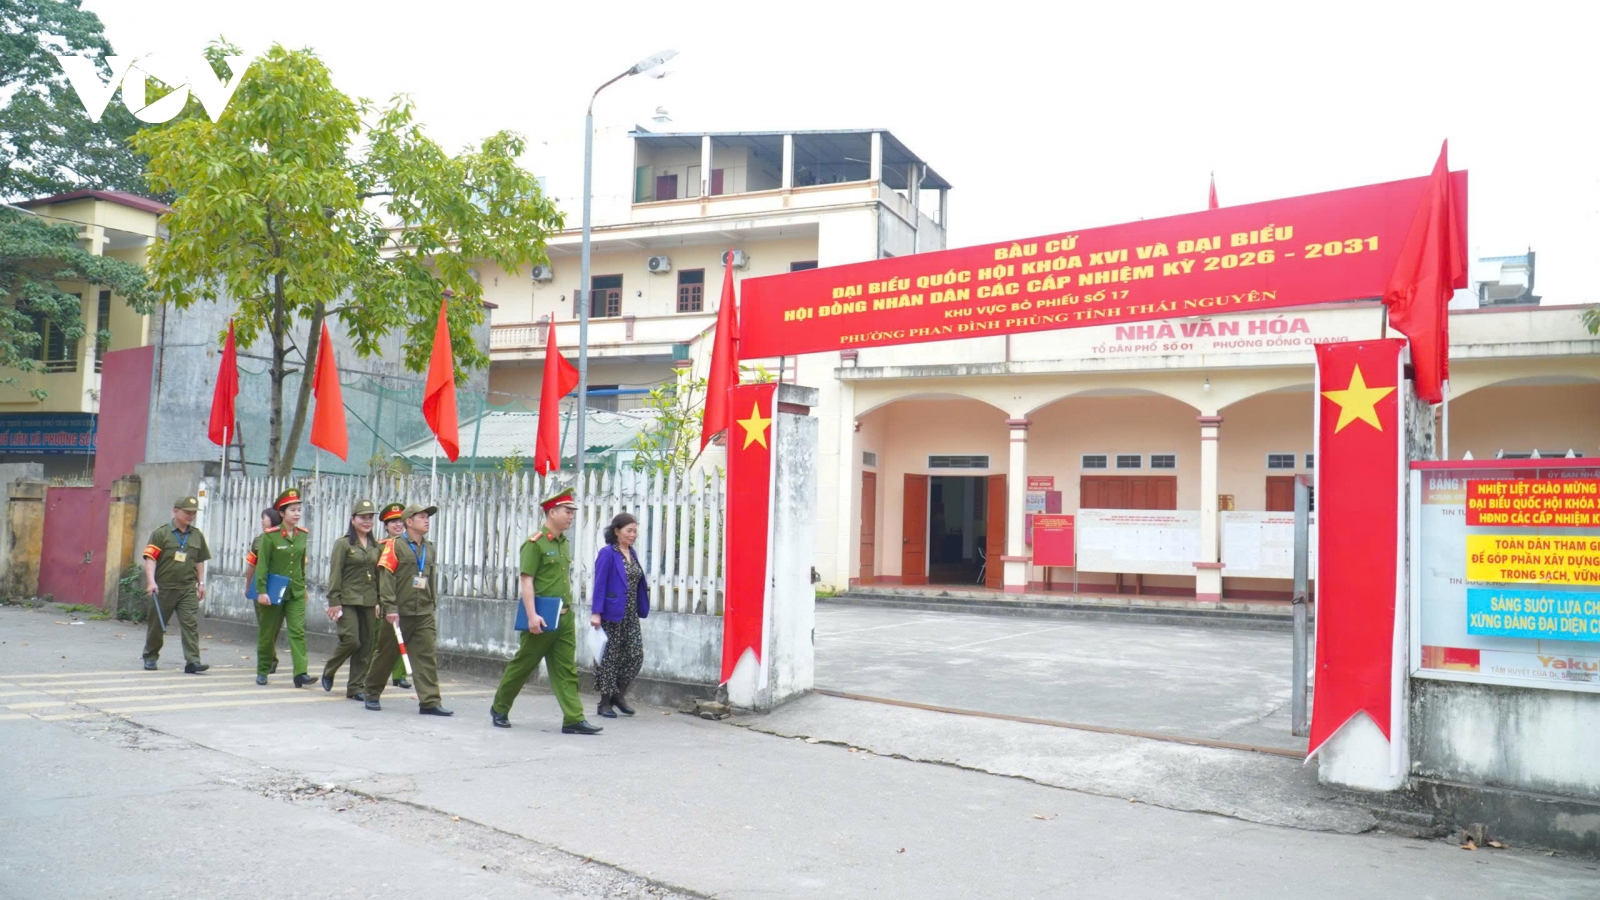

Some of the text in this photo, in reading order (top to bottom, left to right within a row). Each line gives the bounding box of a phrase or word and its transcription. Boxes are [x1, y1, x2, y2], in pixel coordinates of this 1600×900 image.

[994, 235, 1080, 261] BẦU CỬ
[832, 223, 1294, 300] ĐẠI BIỂU QUỐC HỘI KHÓA XVI VÀ ĐẠI BIỂU
[783, 306, 813, 323] HỘI
[818, 299, 867, 317] ĐỒNG
[873, 293, 924, 311] NHÂN
[930, 285, 970, 304] DÂN
[976, 282, 1020, 299] CÁC
[1026, 274, 1072, 293] CẤP
[1078, 265, 1154, 287] NHIỆM
[1163, 258, 1196, 277] KỲ
[1203, 250, 1276, 272] 2026
[1304, 236, 1380, 259] 2031
[944, 289, 1129, 319] KHU VỰC BỎ PHIẾU SỐ 17
[840, 290, 1278, 344] PHƯỜNG PHAN ĐÌNH PHÙNG TỈNH THÁI NGUYÊN
[1115, 314, 1310, 341] NHÀ VĂN HÓA
[1092, 342, 1107, 354] TỔ
[1109, 343, 1132, 354] DÂN
[1134, 340, 1158, 353] PHỐ
[1163, 340, 1178, 351] SỐ
[1213, 337, 1264, 349] PHƯỜNG
[1266, 334, 1302, 347] ĐỒNG
[1304, 335, 1349, 346] QUANG
[10, 430, 28, 446] LIÊN
[43, 429, 78, 446] PHƯỜNG
[1429, 474, 1459, 490] BẢNG
[1561, 471, 1579, 479] BAN
[1478, 481, 1507, 496] NHIỆT
[1509, 481, 1530, 496] LIỆT
[1532, 481, 1561, 494] CHÀO
[1563, 482, 1597, 494] MỪNG
[1469, 499, 1486, 512] ĐẠI
[1489, 495, 1511, 509] BIỂU
[1513, 496, 1541, 510] QUỐC
[1544, 497, 1562, 512] HỘI
[1565, 496, 1595, 509] KHÓA
[1479, 513, 1508, 523] HĐND
[1511, 511, 1530, 523] CÁC
[1532, 510, 1553, 524] CẤP
[1555, 511, 1590, 526] NHIỆM
[1495, 538, 1525, 550] TOÀN
[1528, 538, 1550, 550] DÂN
[1554, 541, 1587, 551] THAM
[1471, 550, 1600, 569] ĐỂ GÓP PHẦN XÂY DỰNG
[1500, 569, 1600, 582] TRONG SẠCH, VỮN
[1490, 594, 1521, 611] SÁNG
[1557, 599, 1582, 617] LỰA
[1470, 611, 1501, 628] XỨNG
[1503, 613, 1536, 631] ĐÁNG
[1538, 617, 1558, 635] ĐẠI
[1560, 616, 1587, 636] DIỆN
[1507, 667, 1530, 676] HUYẾT
[1532, 669, 1547, 677] CỦA
[1537, 655, 1600, 671] Yaku
